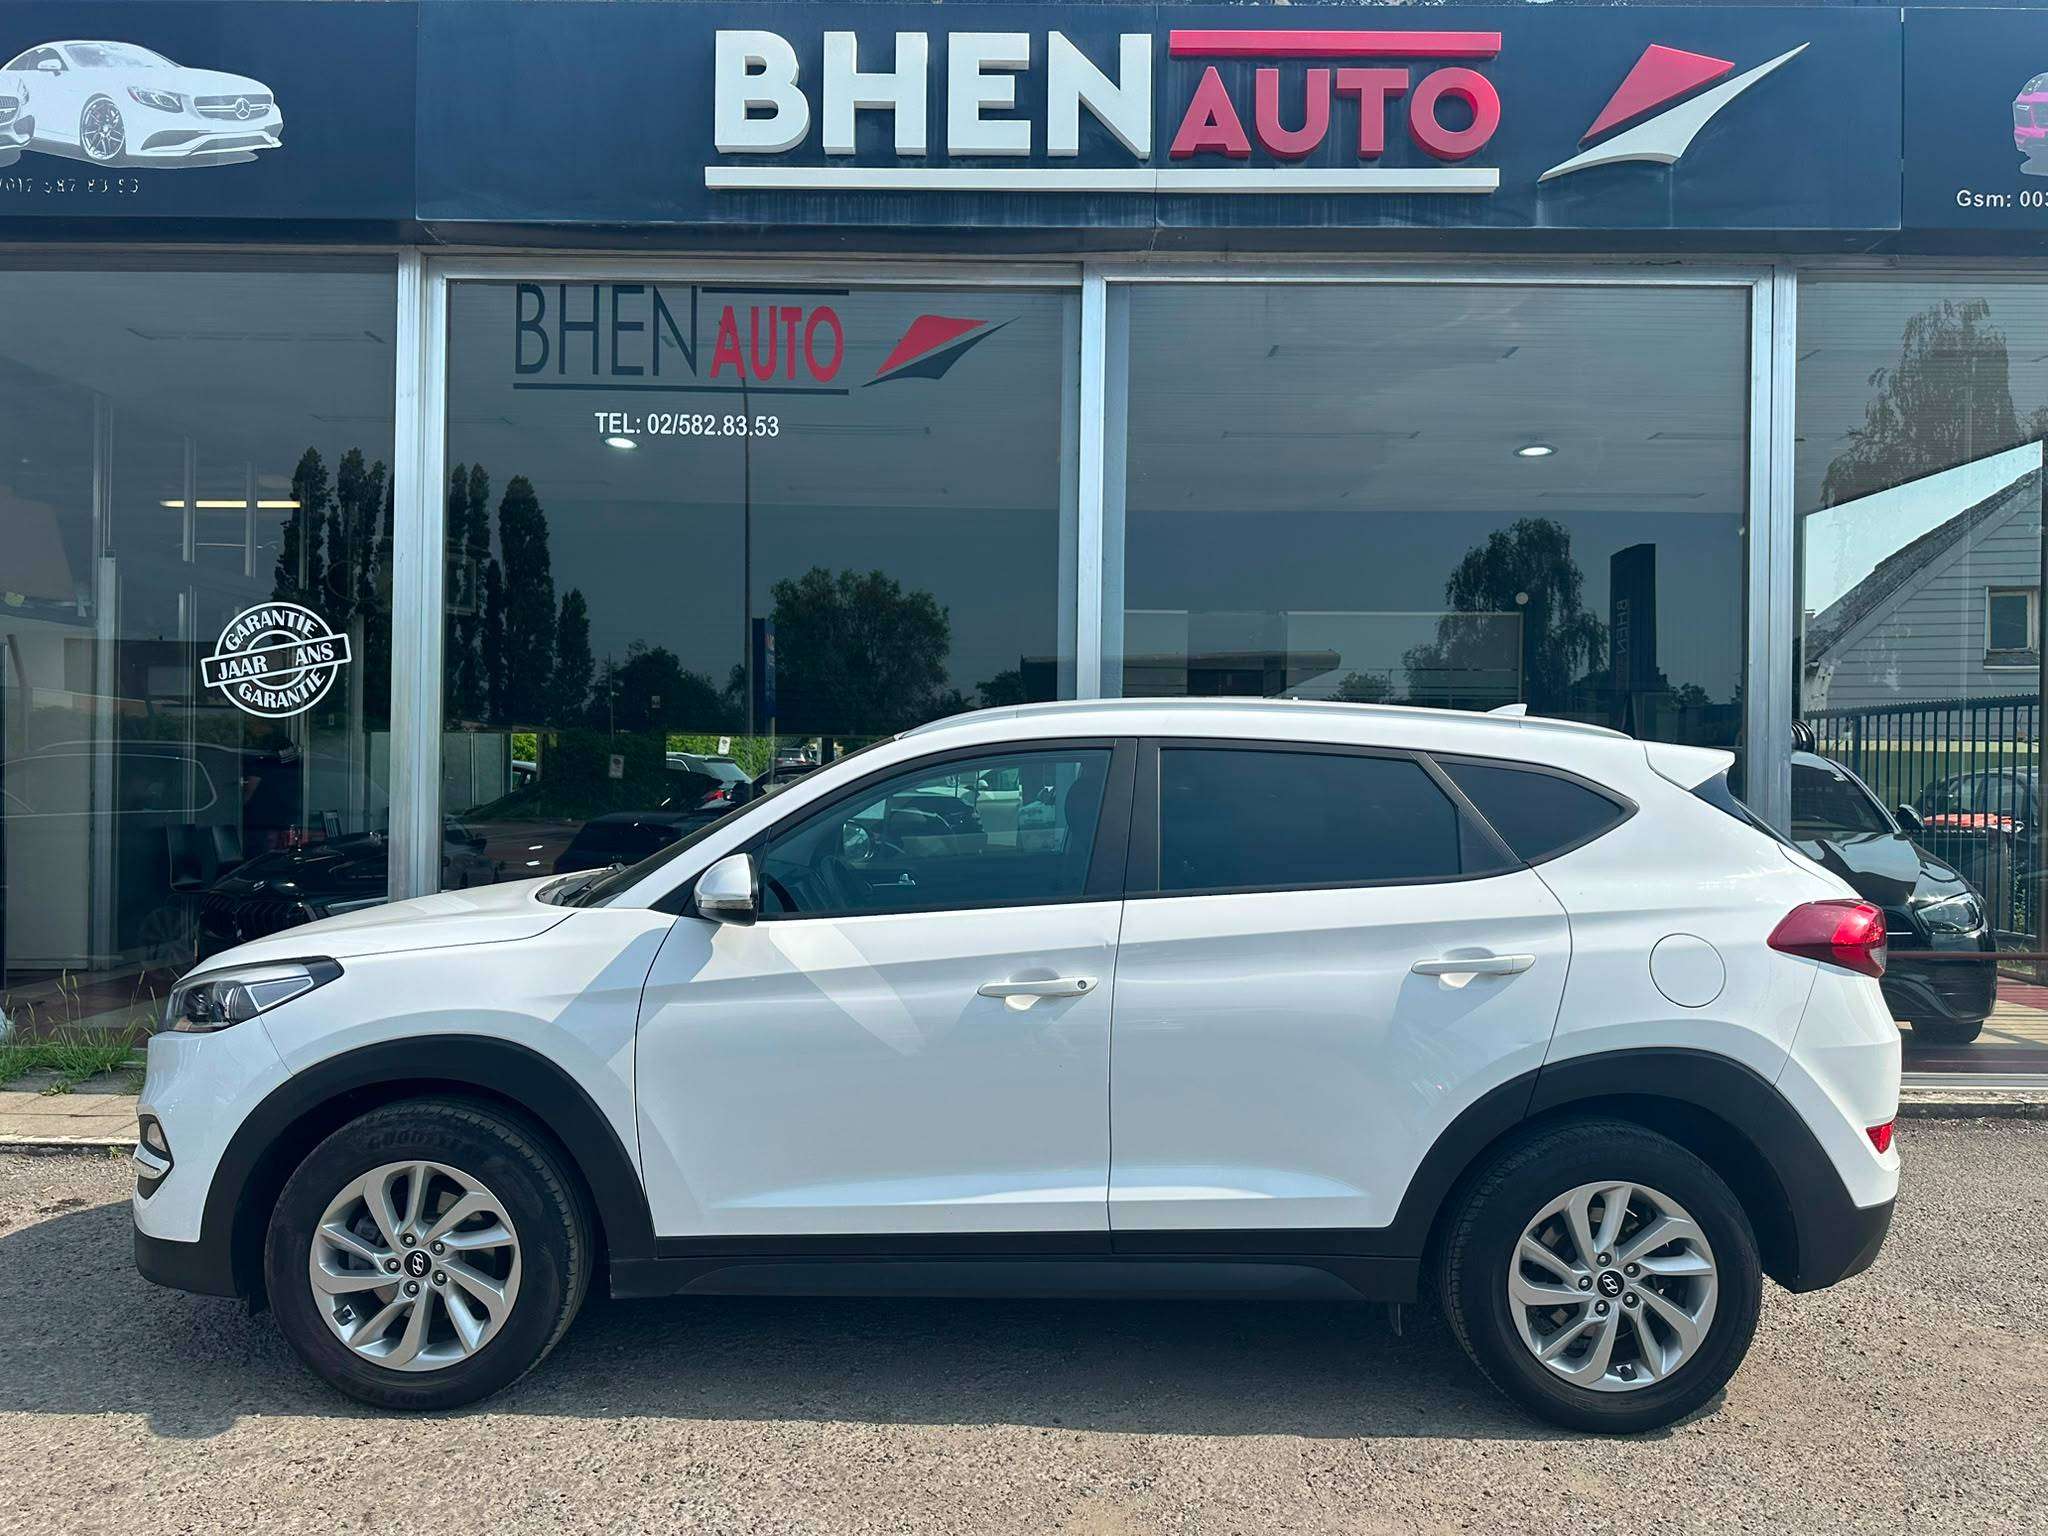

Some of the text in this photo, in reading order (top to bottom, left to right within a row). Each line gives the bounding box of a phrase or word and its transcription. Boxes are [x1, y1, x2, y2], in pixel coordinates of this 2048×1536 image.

[714, 30, 1501, 160] BHEN AUTO
[1956, 190, 2011, 207] Gsm:
[515, 283, 844, 382] BHEN AUTO
[594, 412, 779, 437] TEL: 02/582.83.53
[225, 610, 318, 650] GARANTIE
[218, 642, 335, 680] JAAR ANS
[238, 668, 326, 708] GARANTIE
